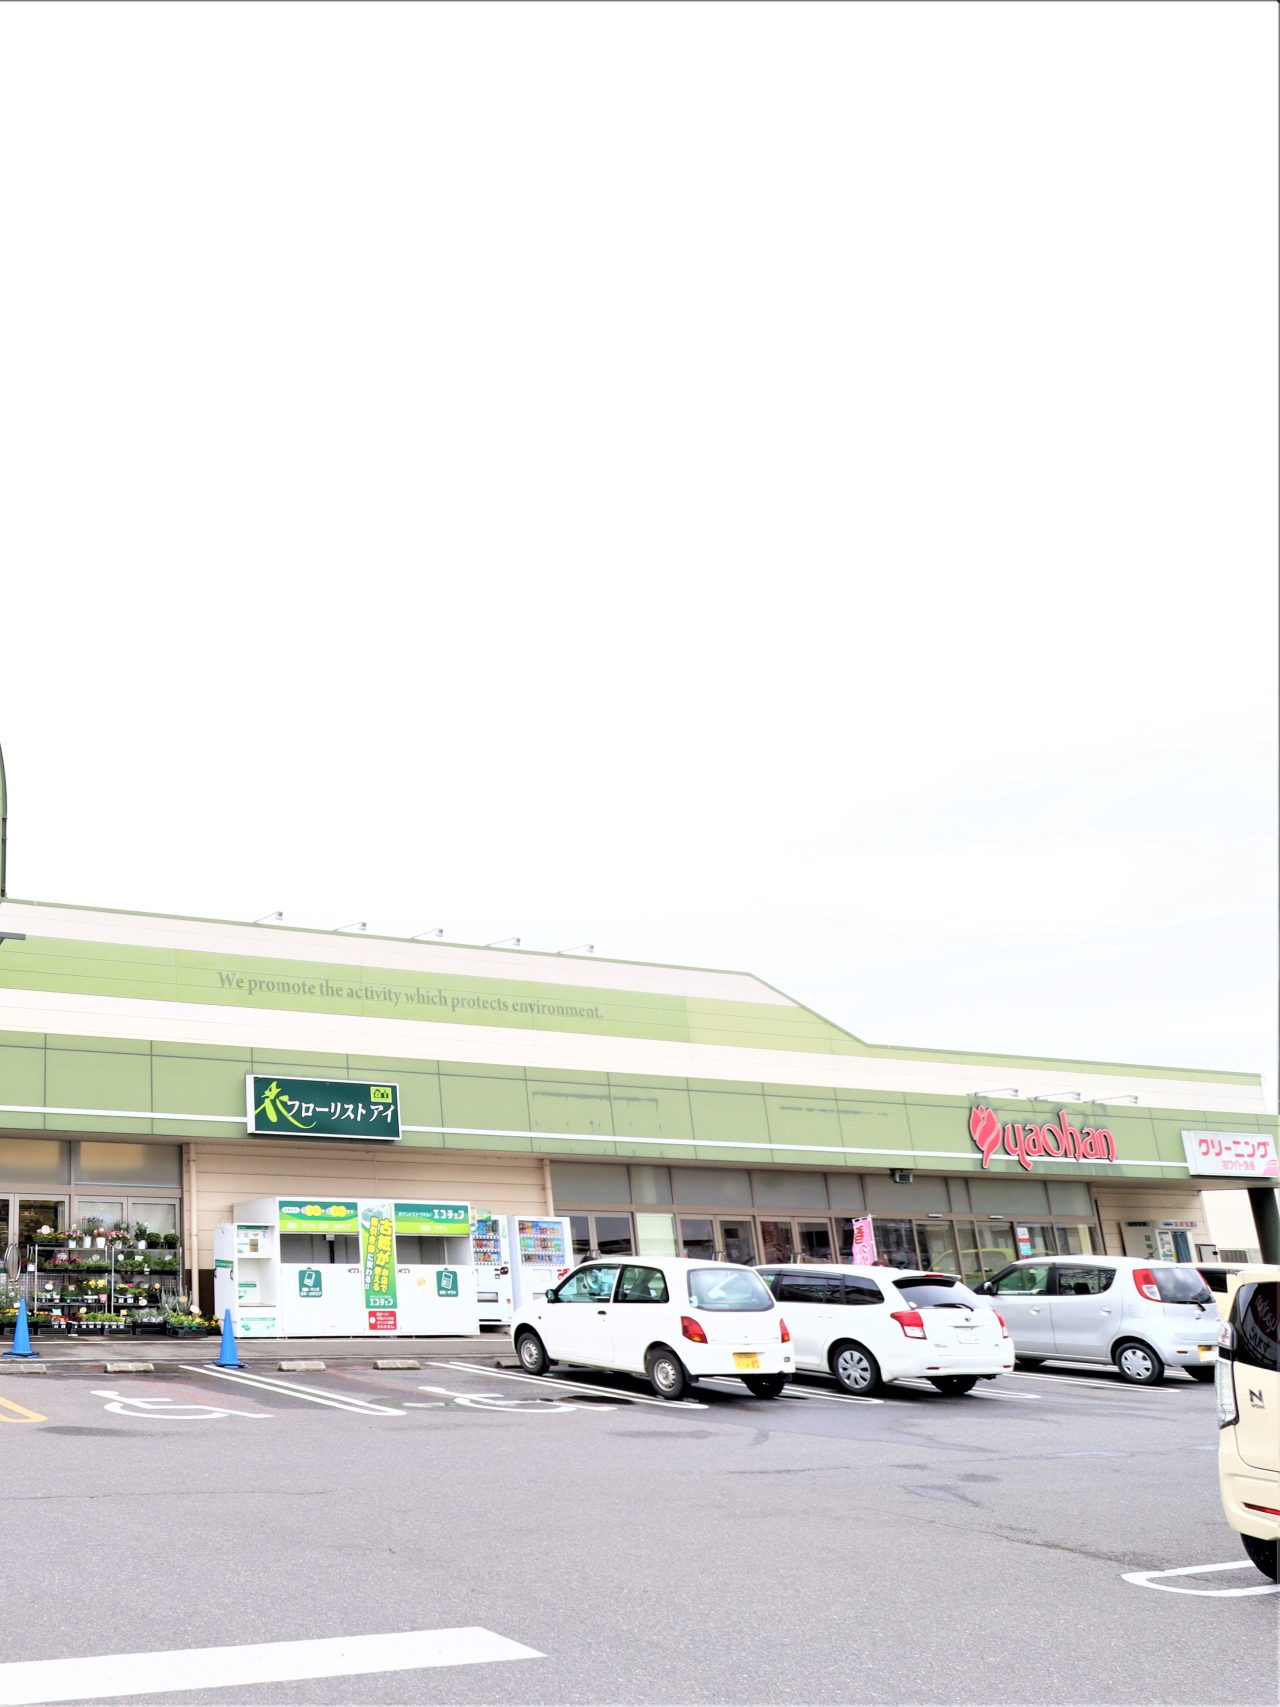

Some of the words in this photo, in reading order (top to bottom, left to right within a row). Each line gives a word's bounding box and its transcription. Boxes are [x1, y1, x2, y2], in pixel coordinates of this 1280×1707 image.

[218, 971, 244, 989] We
[248, 977, 316, 995] promote
[319, 979, 344, 997] the
[346, 985, 402, 1007] activity
[405, 986, 448, 1006] which
[451, 994, 509, 1012] protects
[512, 999, 604, 1020] environment.
[287, 1100, 367, 1122] フローリスト
[369, 1104, 396, 1124] アイ
[1004, 1110, 1117, 1170] yaohan
[1198, 1138, 1270, 1159] クリーニング
